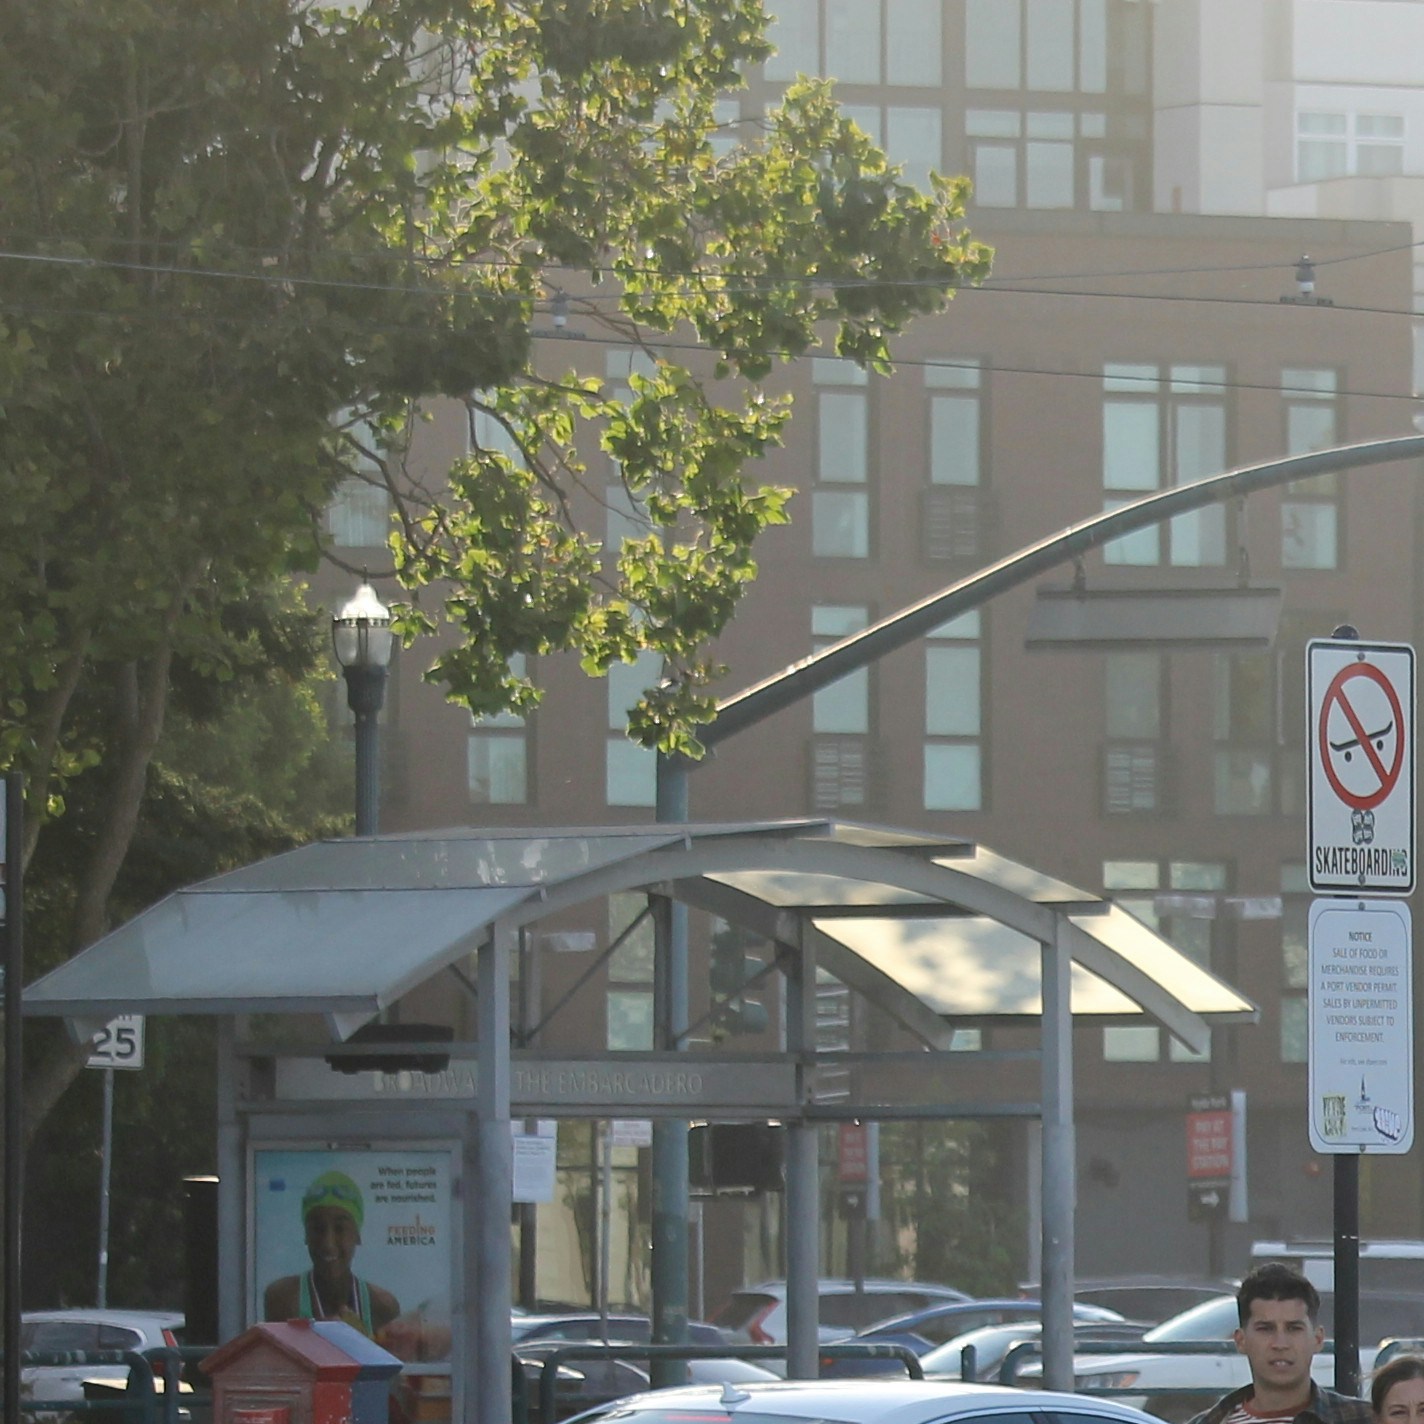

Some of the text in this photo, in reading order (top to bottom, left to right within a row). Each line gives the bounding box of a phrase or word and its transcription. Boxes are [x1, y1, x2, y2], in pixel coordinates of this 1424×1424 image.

[1349, 931, 1372, 942] NOTICE
[1333, 948, 1347, 958] SALE
[1360, 949, 1377, 959] FOOD
[1321, 964, 1367, 975] MERCHANDISE
[1327, 982, 1344, 992] PORT
[1345, 982, 1372, 992] VENDOR
[1323, 998, 1341, 1008] SALES
[1343, 998, 1351, 1008] BY
[1326, 1015, 1357, 1025] VENDORS
[1386, 1016, 1395, 1026] TO
[95, 1028, 136, 1060] 25
[515, 1070, 551, 1095] THE
[559, 1070, 703, 1096] EMBARCADERO
[387, 1236, 436, 1246] AMERICA
